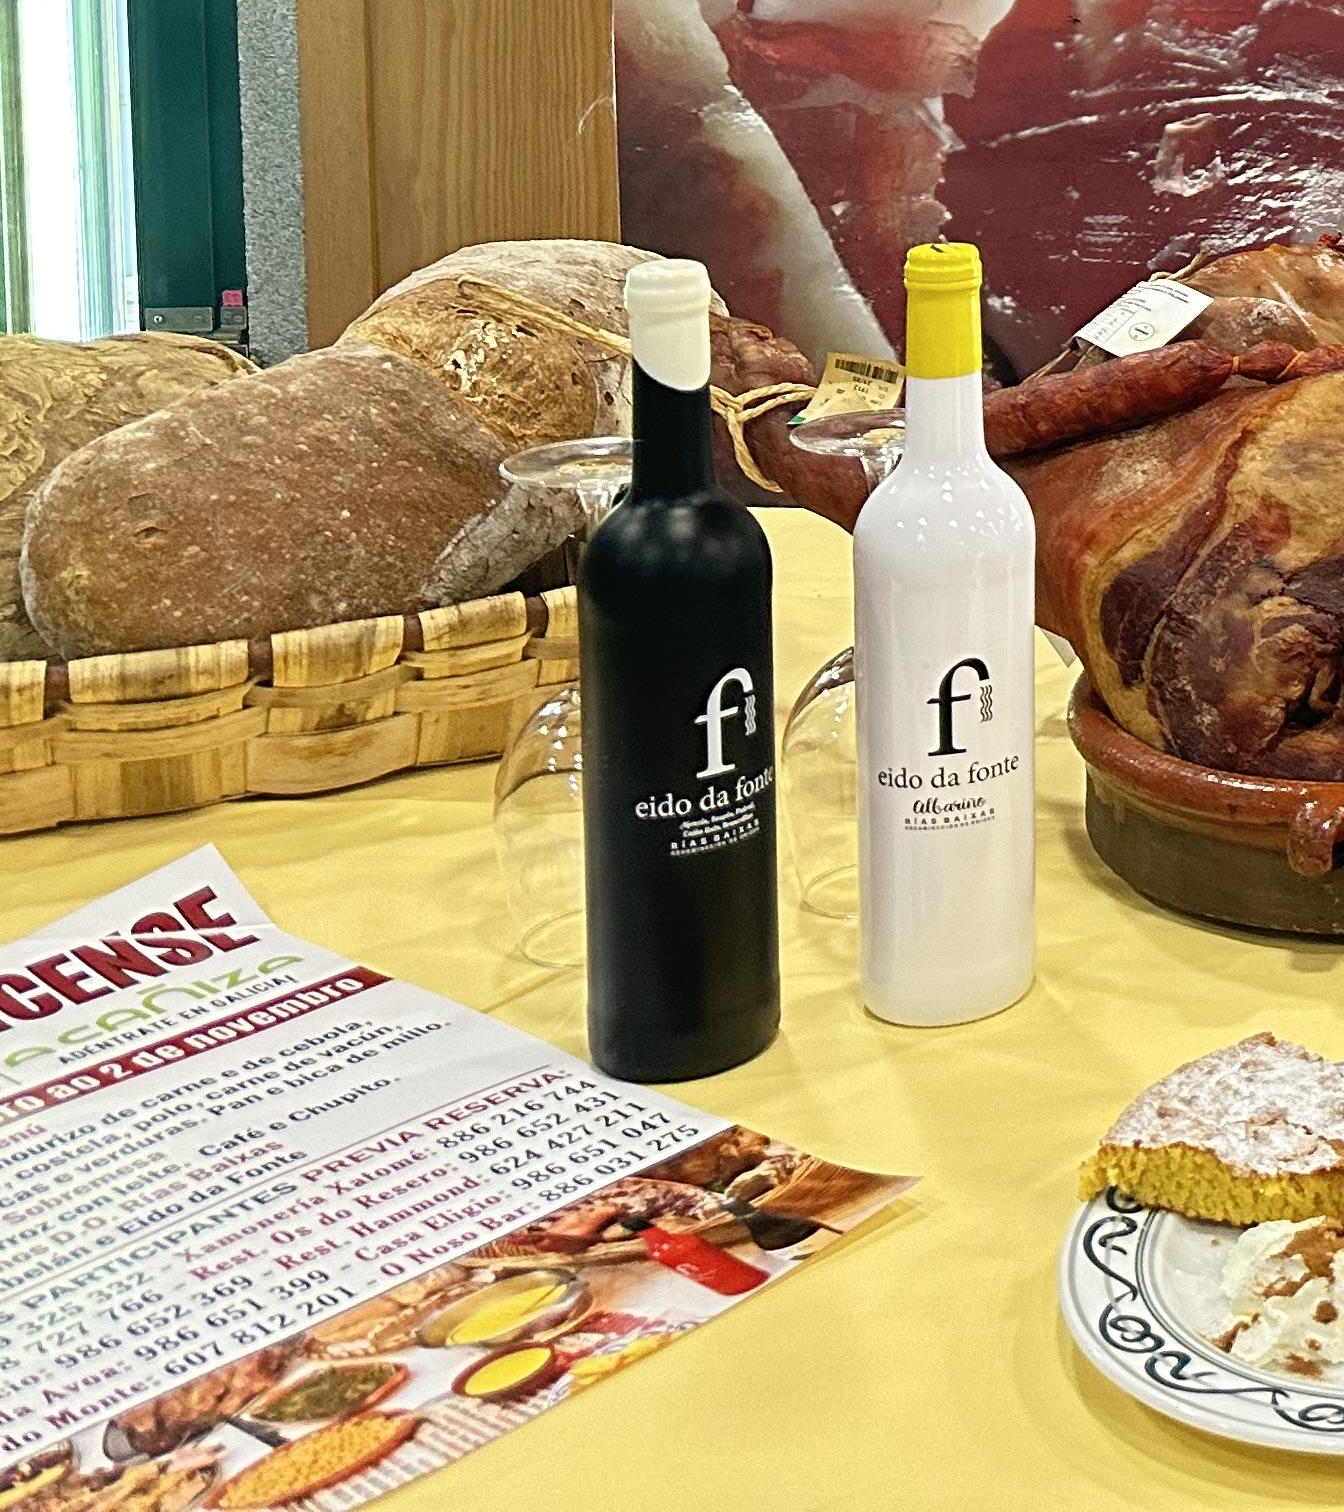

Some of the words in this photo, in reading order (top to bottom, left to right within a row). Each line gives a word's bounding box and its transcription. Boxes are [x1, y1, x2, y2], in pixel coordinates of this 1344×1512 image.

[694, 668, 754, 779] f
[927, 657, 989, 756] f
[635, 793, 692, 819] eido
[700, 786, 730, 812] da
[736, 766, 773, 801] fonte
[878, 768, 923, 789] eido
[931, 768, 960, 788] da
[968, 755, 1019, 784] fonte
[0, 886, 260, 1028] CENSE
[58, 954, 304, 1045] CAÑIZA
[46, 1070, 100, 1103] ao
[99, 1058, 132, 1083] 2
[131, 1040, 185, 1070] de
[183, 975, 365, 1051] novembro
[140, 1074, 217, 1110] carne
[240, 1053, 275, 1071] de
[204, 1069, 281, 1101] carne
[280, 1054, 317, 1072] de
[205, 1091, 262, 1118] Pan
[283, 1061, 344, 1088] bica
[286, 1073, 404, 1124] Chupito.
[436, 1121, 490, 1149] 886
[493, 1099, 545, 1125] 216
[543, 1077, 598, 1104] 744
[20, 1179, 300, 1313] PARTICIPANTES
[301, 1127, 423, 1184] PREVIA
[423, 1066, 571, 1133] RESERVA:
[187, 1135, 283, 1185] Baixas
[225, 1141, 308, 1192] Fonte
[353, 1158, 459, 1211] Resero:
[457, 1135, 514, 1165] 986
[514, 1110, 570, 1139] 652
[570, 1089, 622, 1114] 431
[134, 1323, 200, 1365] 986
[205, 1293, 266, 1332] 651
[268, 1265, 331, 1303] 399
[354, 1226, 423, 1264] Casa
[510, 1161, 567, 1191] 986
[566, 1137, 620, 1165] 651
[619, 1112, 673, 1139] 047
[190, 1271, 253, 1310] 369
[348, 1170, 490, 1239] Hammond:
[487, 1146, 544, 1176] 624
[543, 1124, 595, 1150] 427
[593, 1100, 649, 1127] 211
[163, 1338, 225, 1379] 607
[230, 1308, 295, 1349] 812
[295, 1280, 358, 1319] 201
[406, 1226, 479, 1266] Noso
[537, 1173, 594, 1202] 886
[593, 1149, 647, 1177] 031
[644, 1123, 701, 1152] 275
